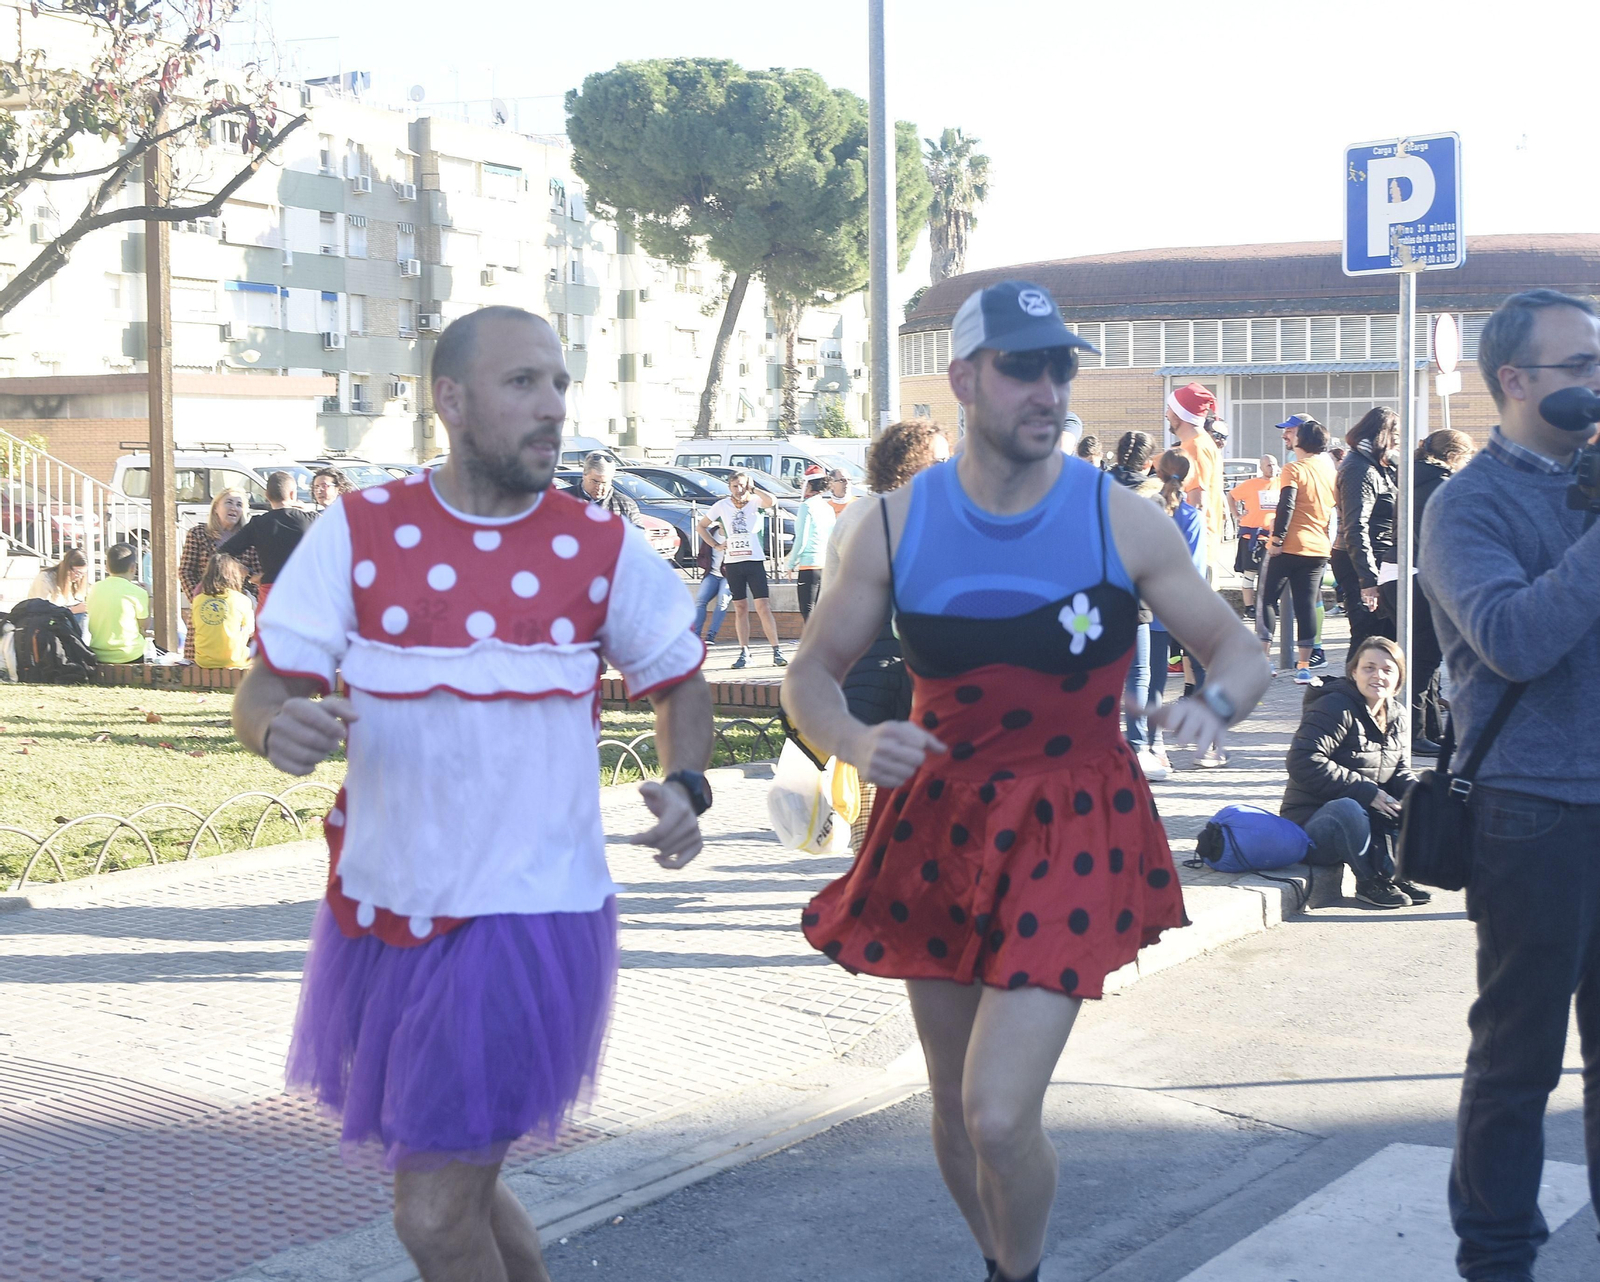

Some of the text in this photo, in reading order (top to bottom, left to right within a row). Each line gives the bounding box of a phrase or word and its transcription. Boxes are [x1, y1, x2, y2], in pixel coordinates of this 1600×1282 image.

[1373, 147, 1392, 156] Carga
[1367, 155, 1436, 258] P
[1417, 224, 1426, 233] 30
[1429, 222, 1455, 232] minutos
[1423, 234, 1437, 243] 08:00
[1441, 232, 1455, 241] 14:00
[1437, 243, 1455, 252] 20:00
[1441, 253, 1455, 263] 14:00
[731, 541, 750, 549] 1224
